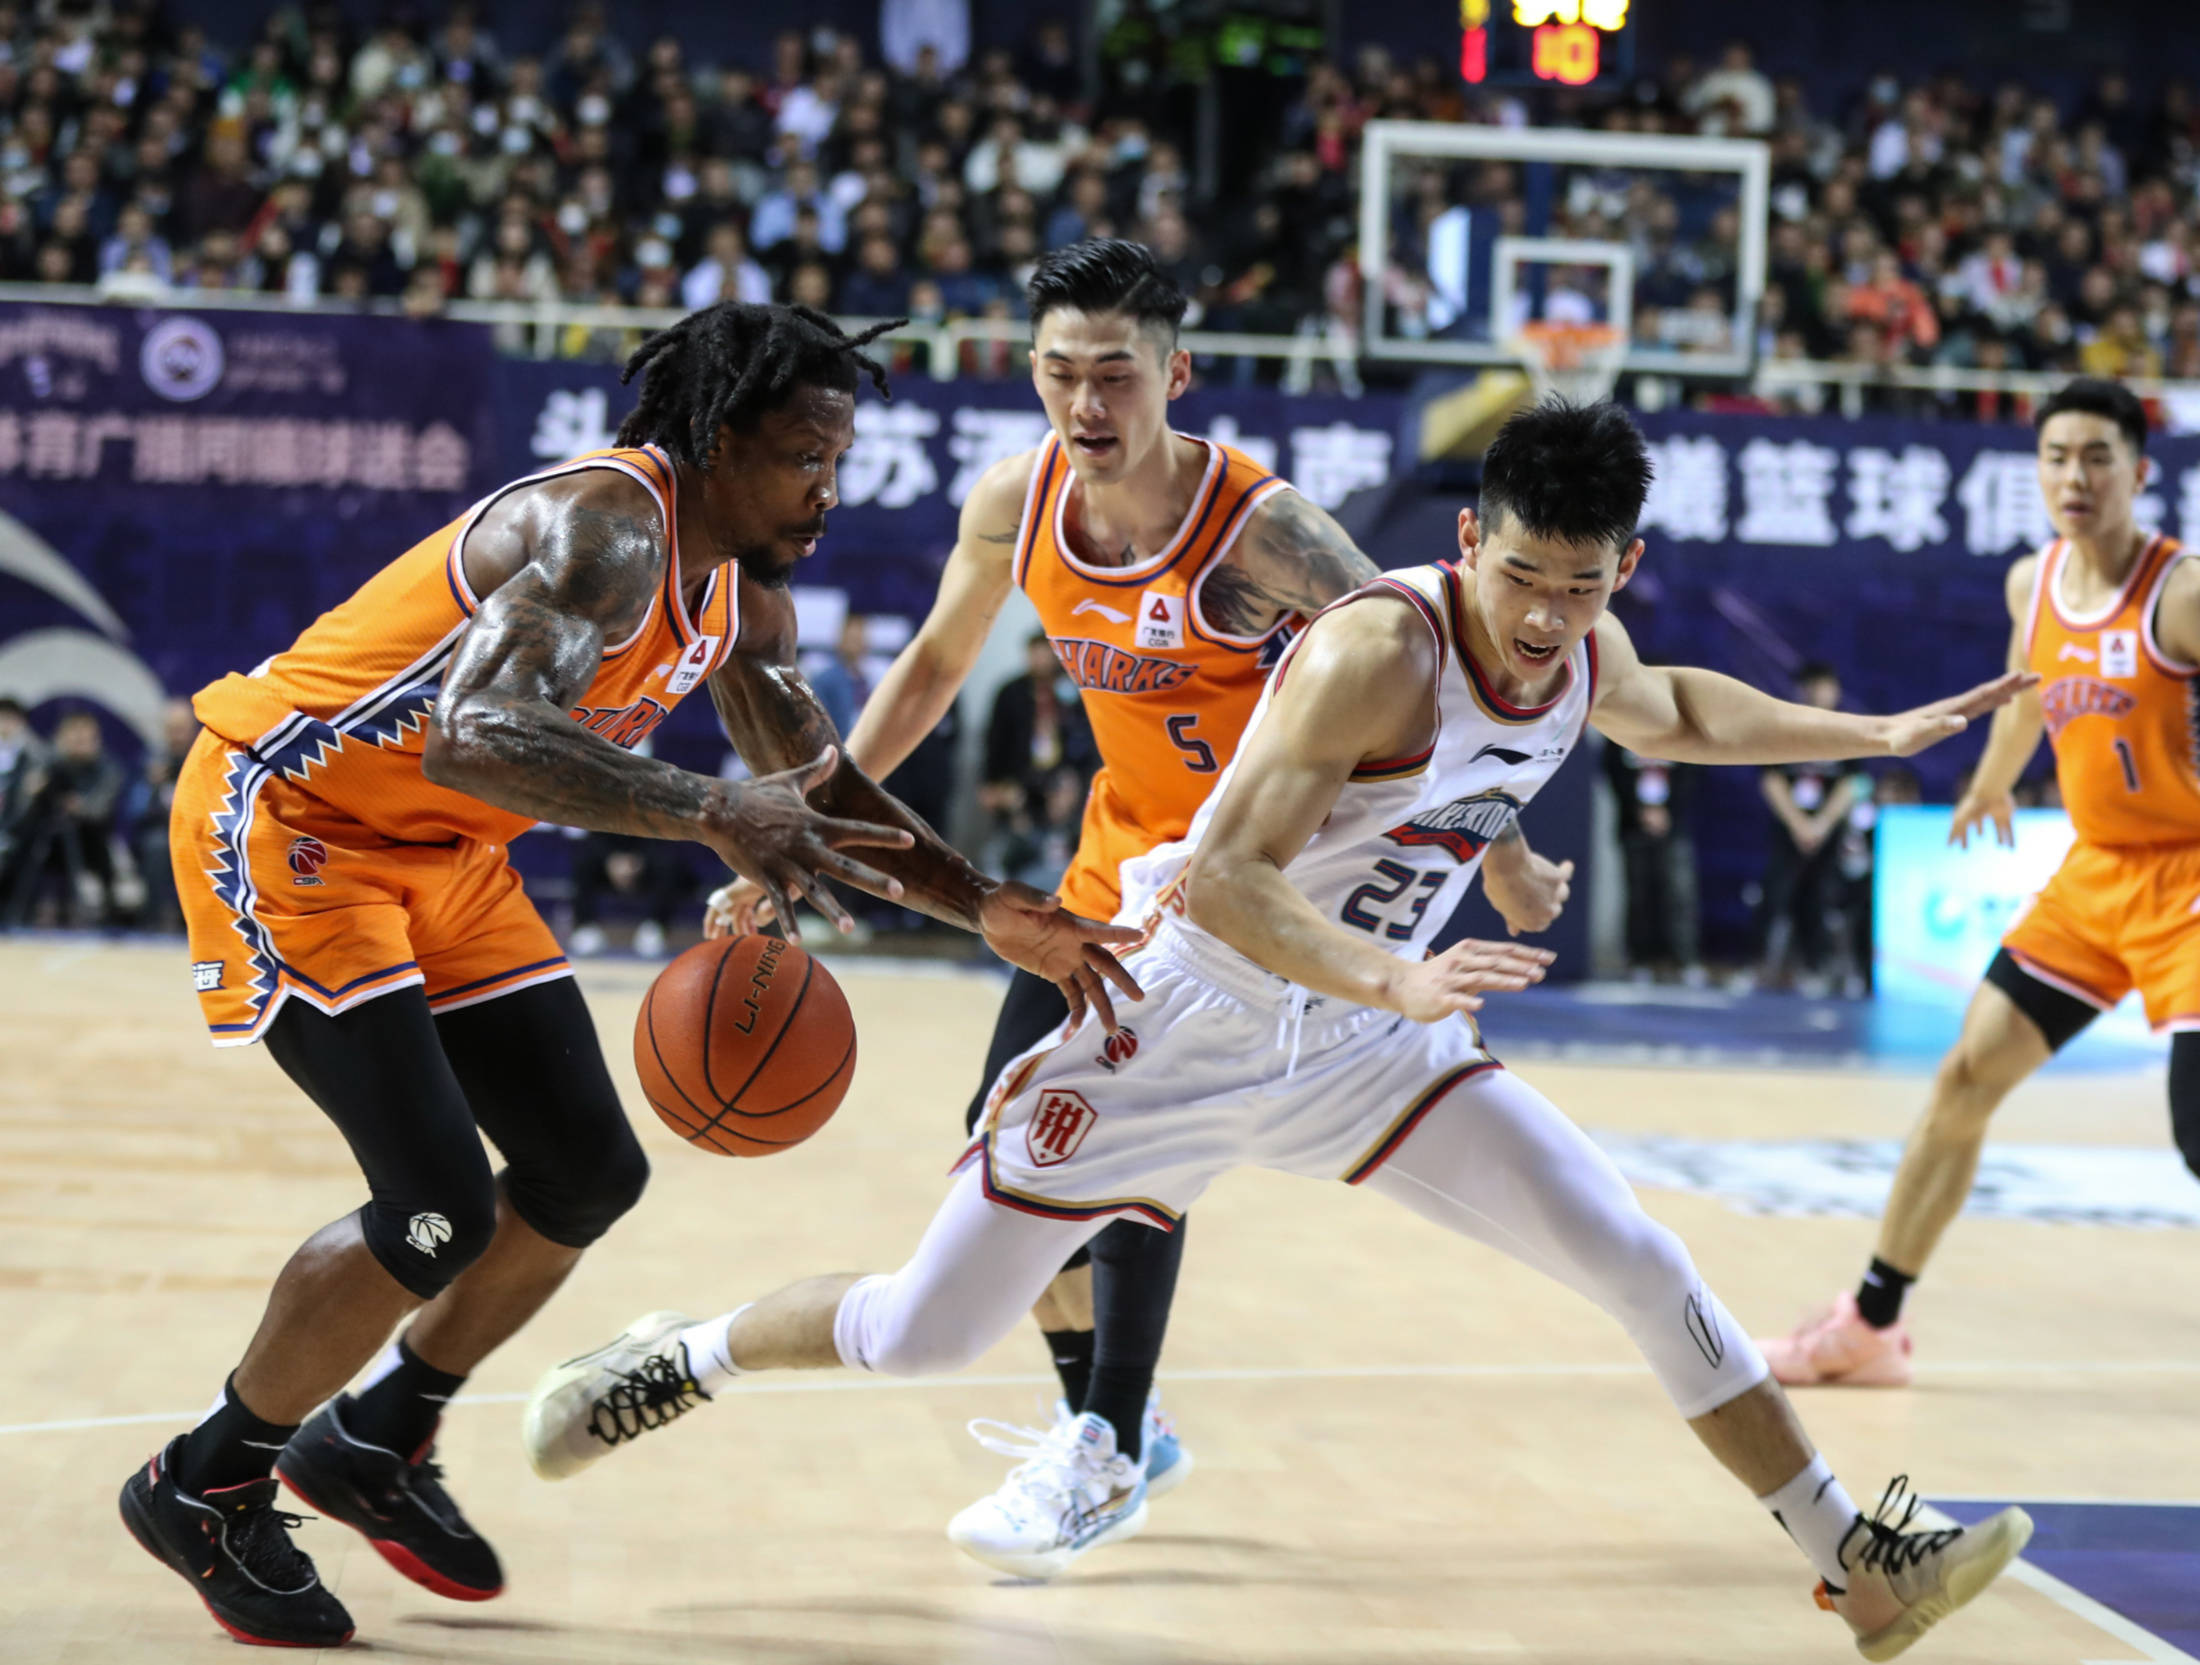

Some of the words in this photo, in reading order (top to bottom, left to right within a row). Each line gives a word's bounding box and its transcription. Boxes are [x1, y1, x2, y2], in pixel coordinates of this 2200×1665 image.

[1049, 637, 1199, 693] HARKS
[1165, 713, 1218, 773] 5
[2113, 738, 2141, 793] 1
[1340, 858, 1449, 941] 23
[734, 940, 786, 1035] LI-NING
